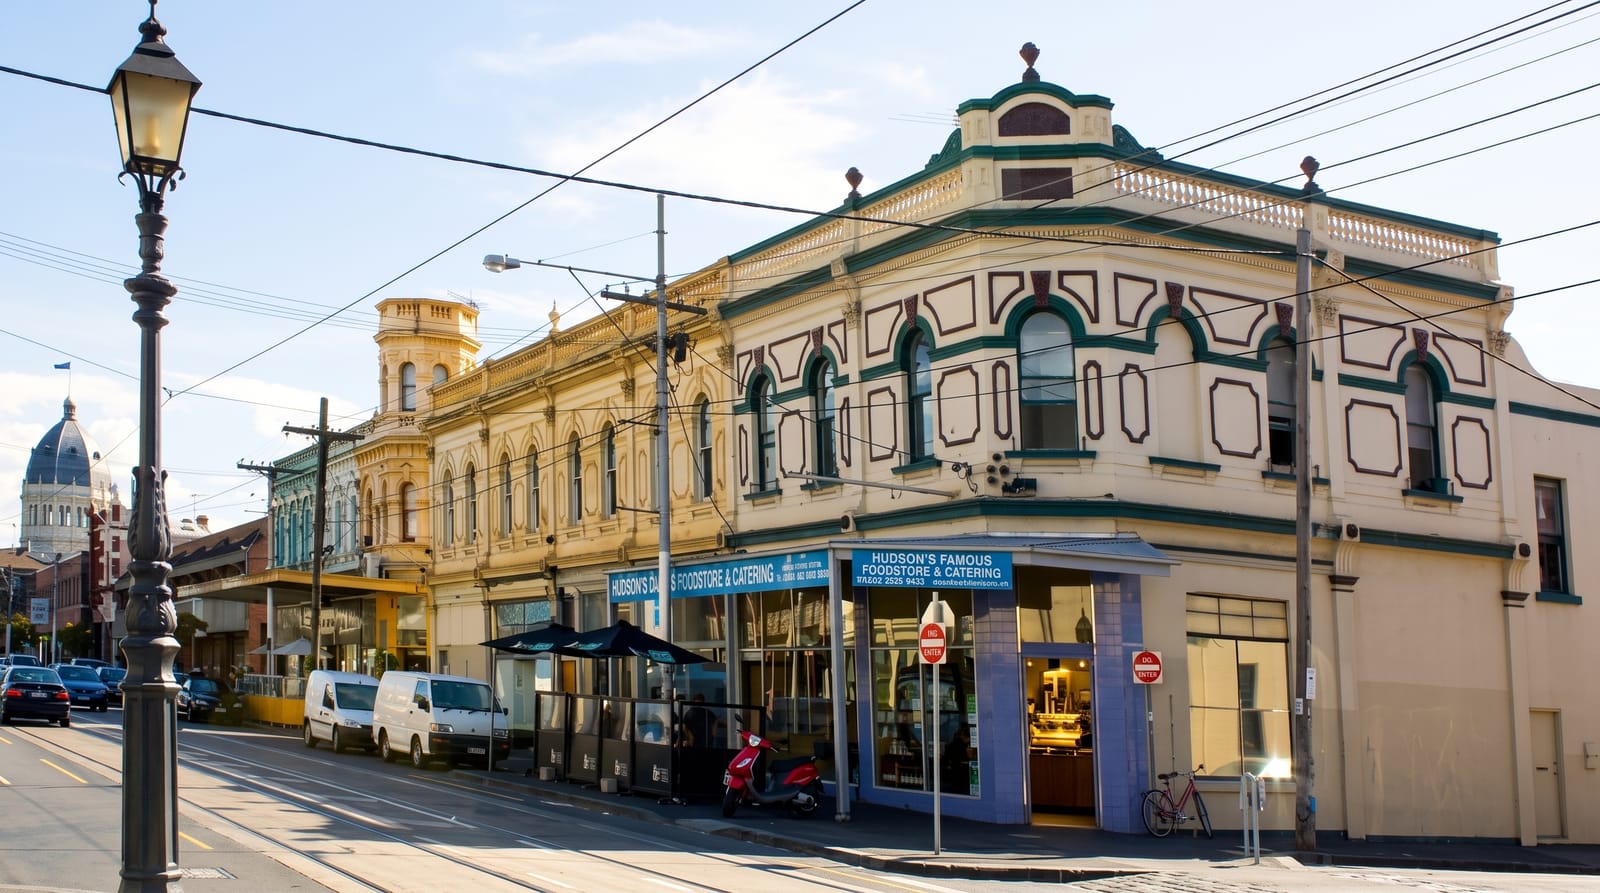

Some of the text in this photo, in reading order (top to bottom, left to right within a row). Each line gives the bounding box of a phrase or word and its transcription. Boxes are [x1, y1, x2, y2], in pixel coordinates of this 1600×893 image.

[872, 552, 992, 566] HUDSON'S FAMOUS
[862, 564, 1001, 578] FOODSTORE & CATERING
[612, 576, 648, 597] HUDSON'S
[677, 568, 723, 591] FOODSTORE
[725, 568, 731, 587] &
[733, 563, 774, 586] CATERING
[884, 577, 903, 585] 2525
[905, 577, 925, 585] 9433
[924, 649, 942, 657] ENTER
